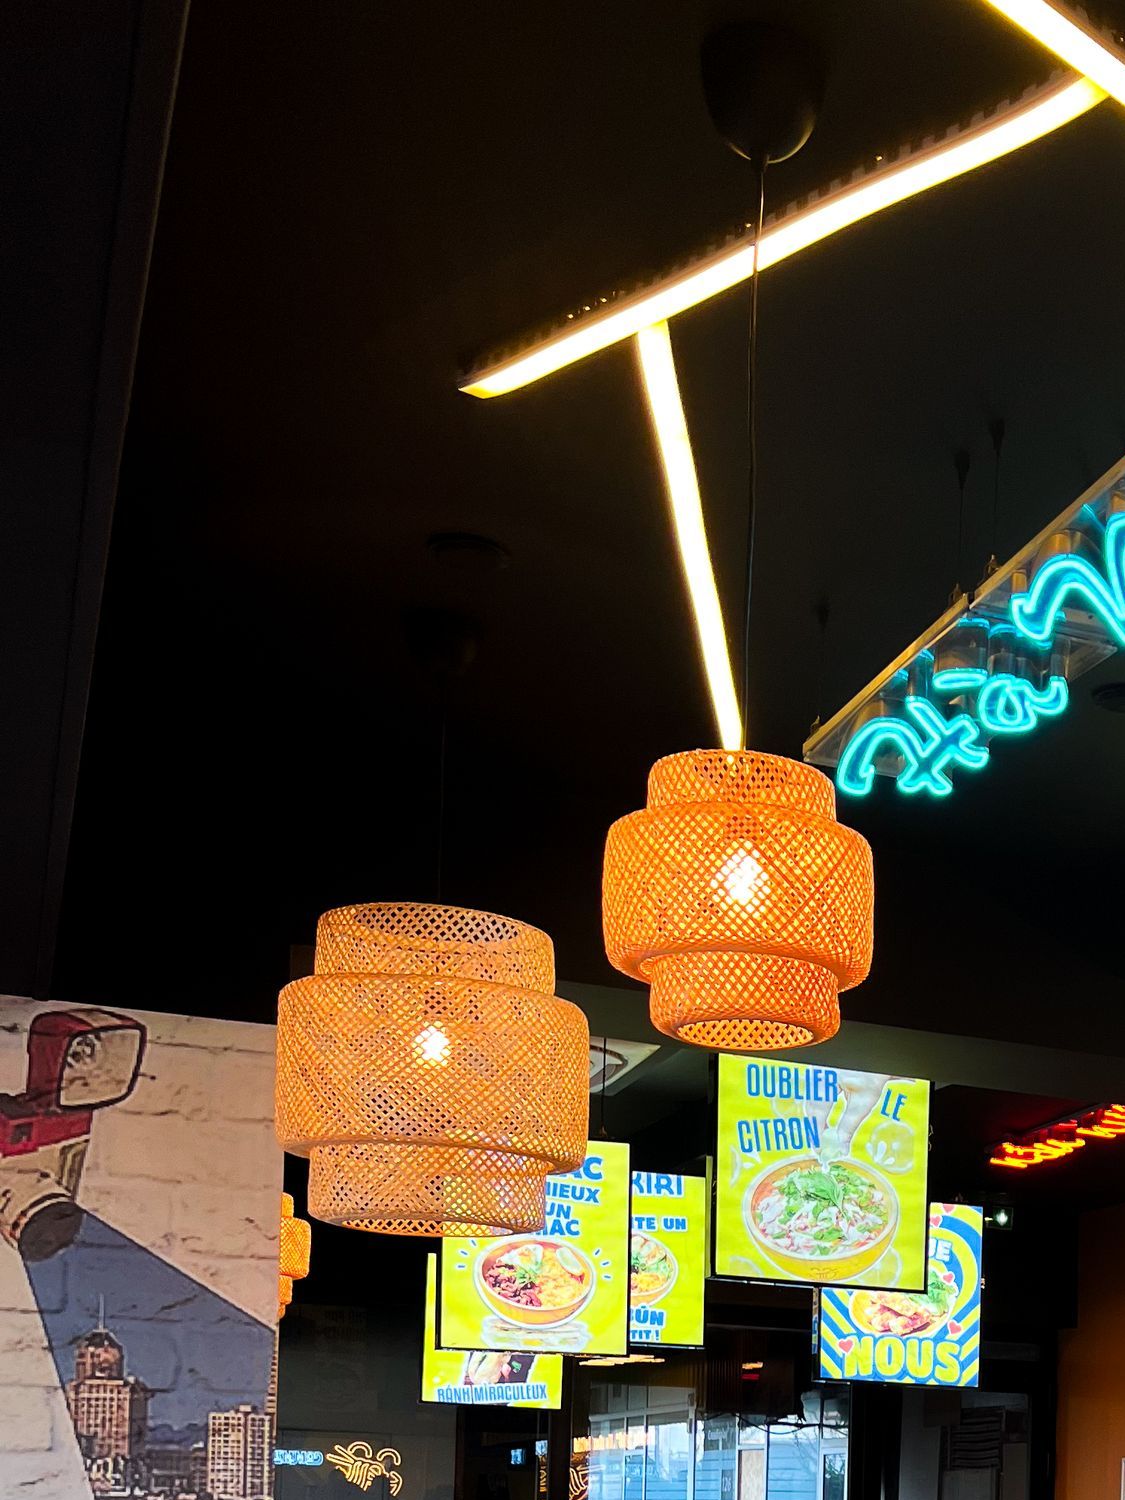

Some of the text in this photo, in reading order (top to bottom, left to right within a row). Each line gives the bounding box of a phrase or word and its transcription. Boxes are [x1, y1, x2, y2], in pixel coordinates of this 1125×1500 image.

[746, 1063, 908, 1121] OUBLIER LE
[737, 1116, 821, 1153] CITRON
[632, 1216, 687, 1230] TE UN
[631, 1305, 664, 1326] ÚN
[843, 1335, 962, 1384] NOUS
